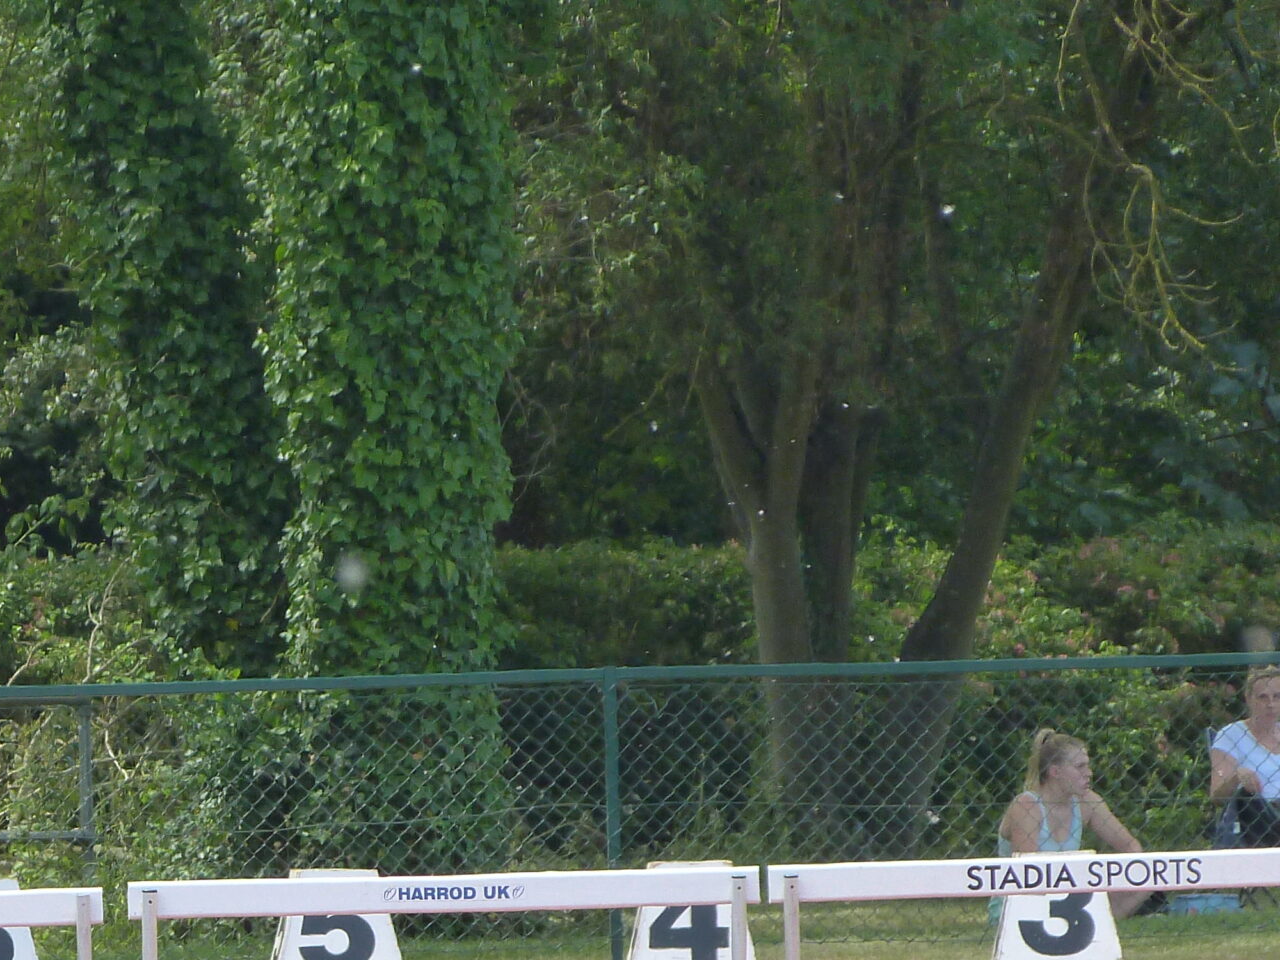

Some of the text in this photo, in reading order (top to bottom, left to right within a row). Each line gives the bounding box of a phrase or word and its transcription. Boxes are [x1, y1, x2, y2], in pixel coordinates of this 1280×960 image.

[967, 858, 1203, 891] STADIA SPORTS
[398, 885, 511, 900] HARROD UK
[1017, 891, 1097, 956] 3
